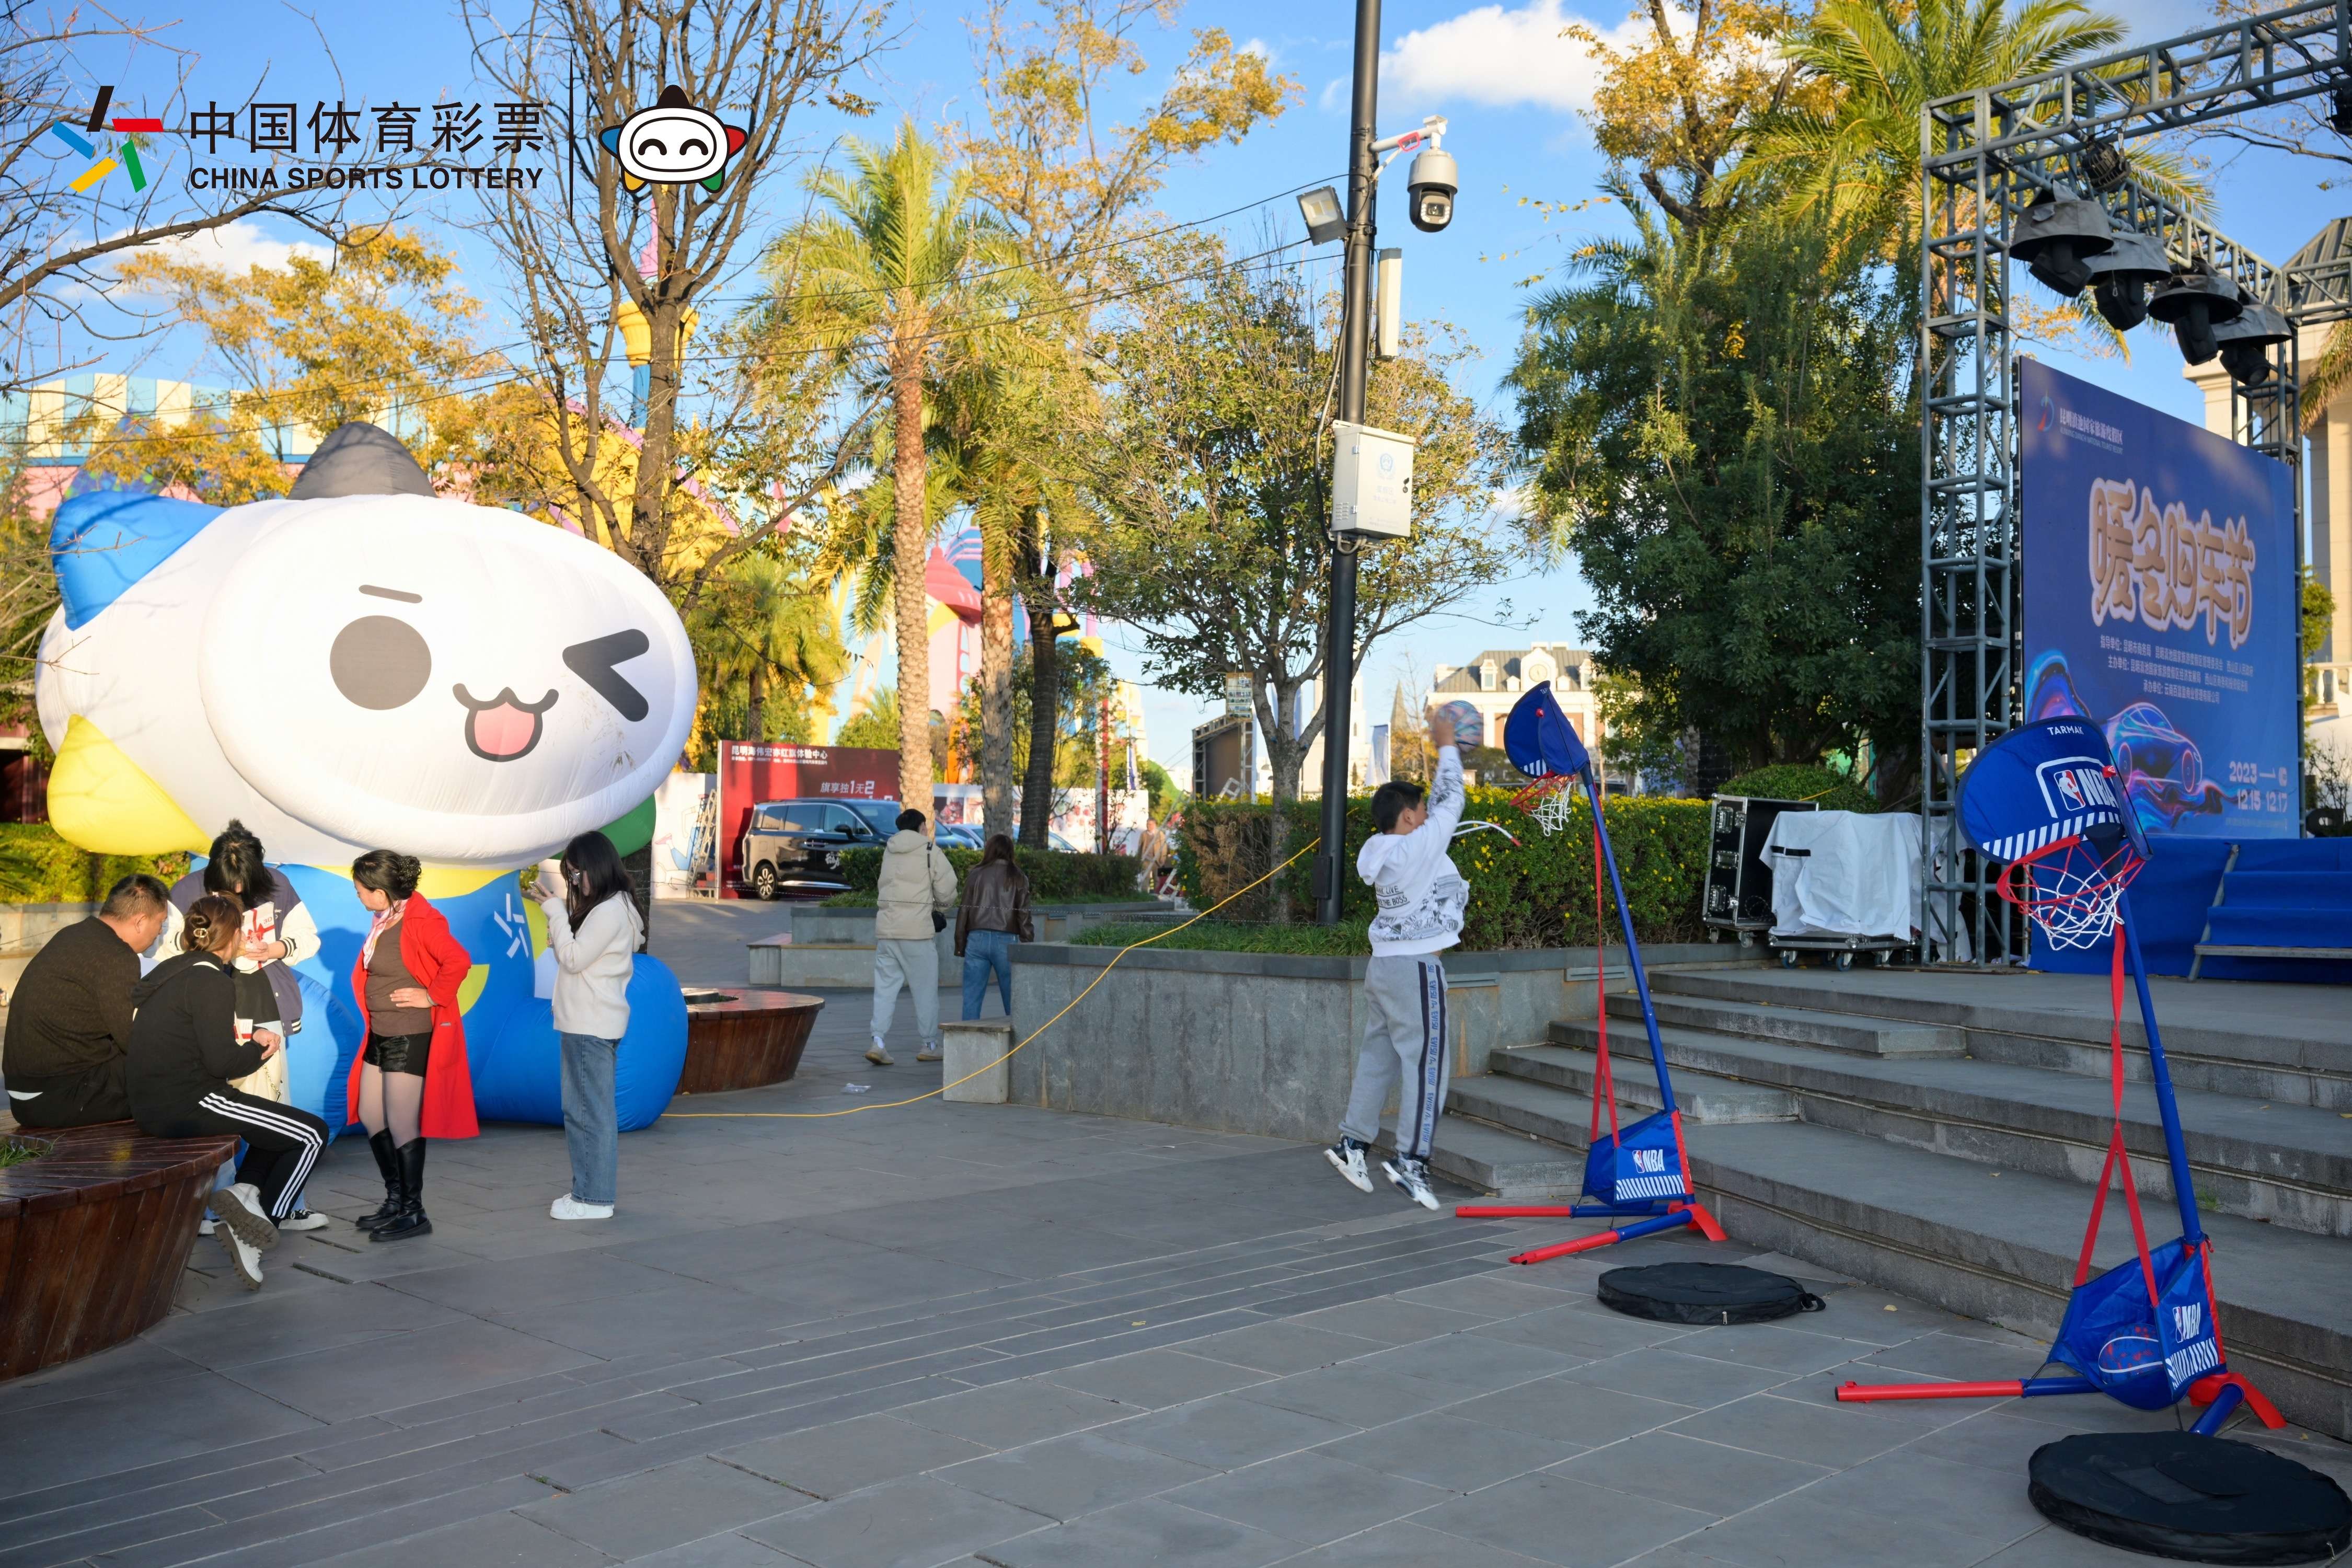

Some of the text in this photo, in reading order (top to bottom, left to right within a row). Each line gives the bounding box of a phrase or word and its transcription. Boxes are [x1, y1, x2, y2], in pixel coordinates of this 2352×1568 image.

[2047, 725, 2084, 735] TARMAK
[2229, 761, 2257, 784] 2023
[2076, 768, 2119, 809] NBA
[1392, 895, 1408, 905] BOSS
[1642, 1149, 1665, 1172] NBA
[2182, 1301, 2201, 1340] NBA
